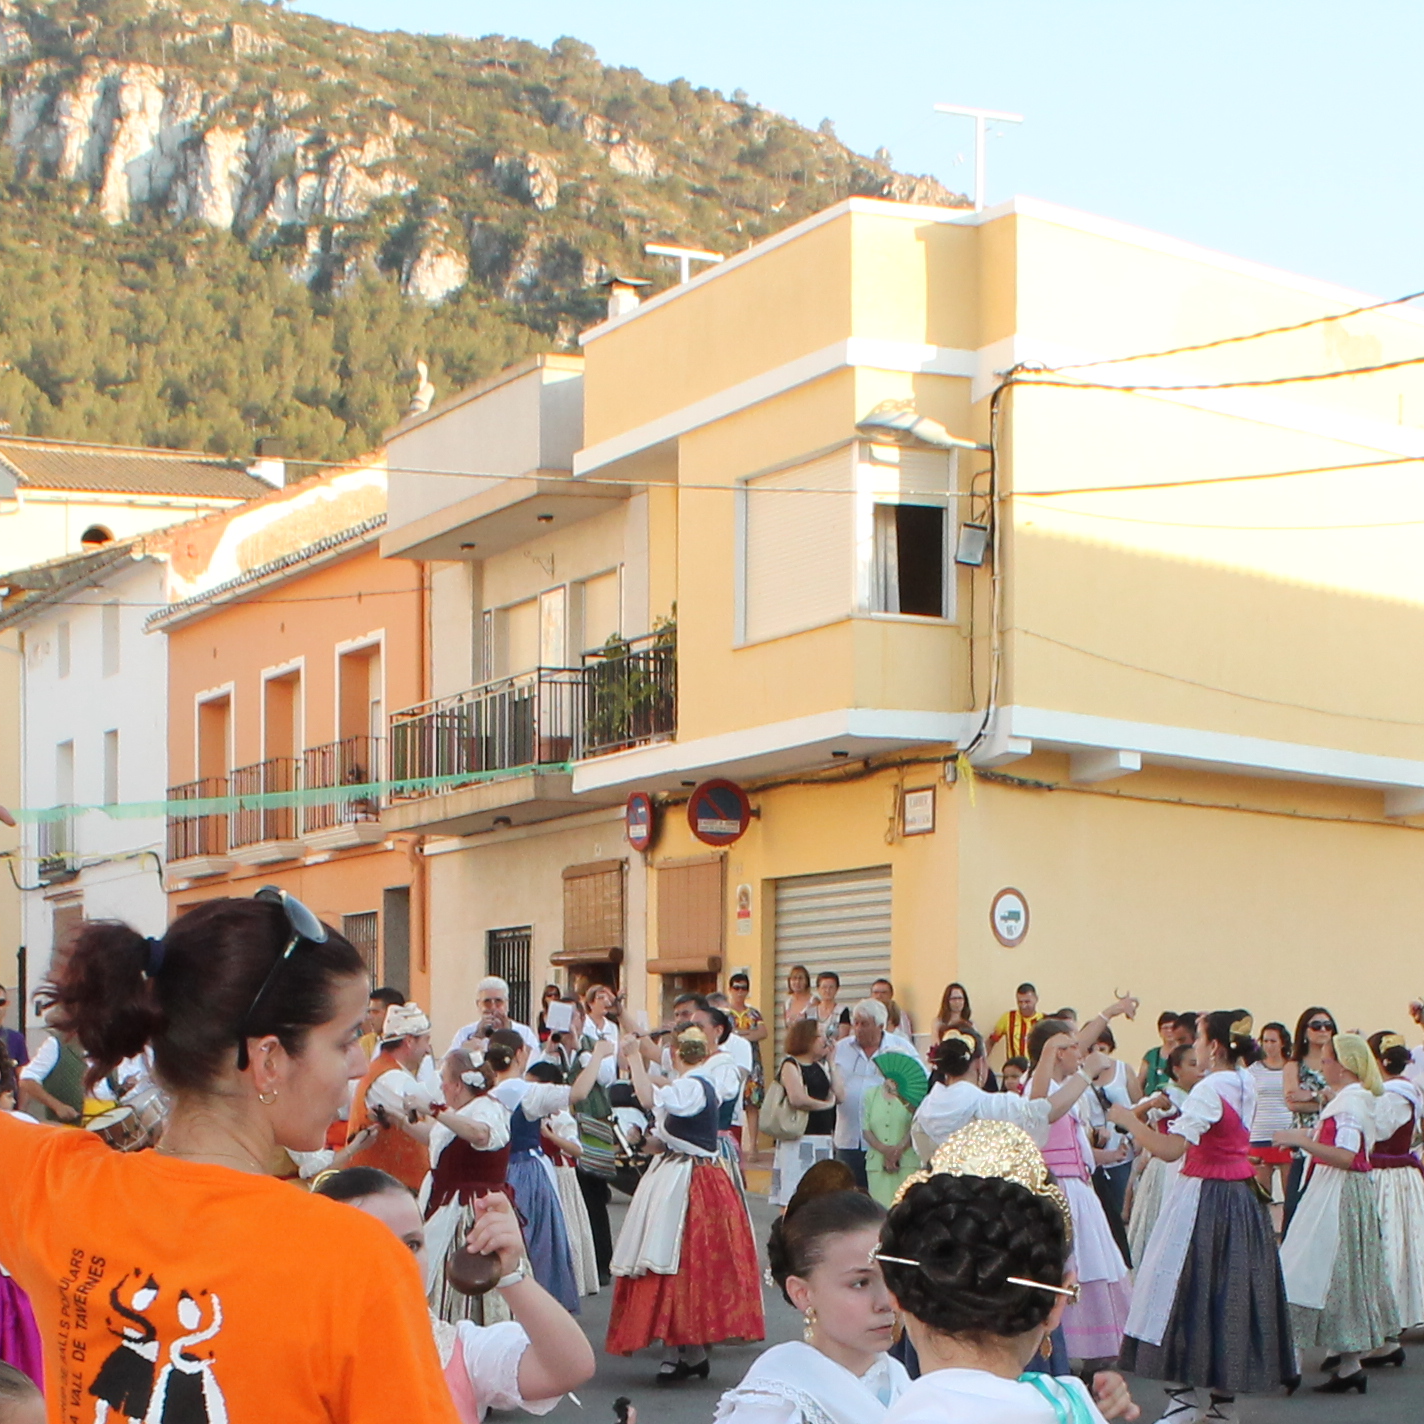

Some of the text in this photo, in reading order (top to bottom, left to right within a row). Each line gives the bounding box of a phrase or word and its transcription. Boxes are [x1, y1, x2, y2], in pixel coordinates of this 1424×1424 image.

[74, 1256, 106, 1330] TAVERNES
[72, 1340, 86, 1362] DE
[71, 1371, 82, 1406] VALL
